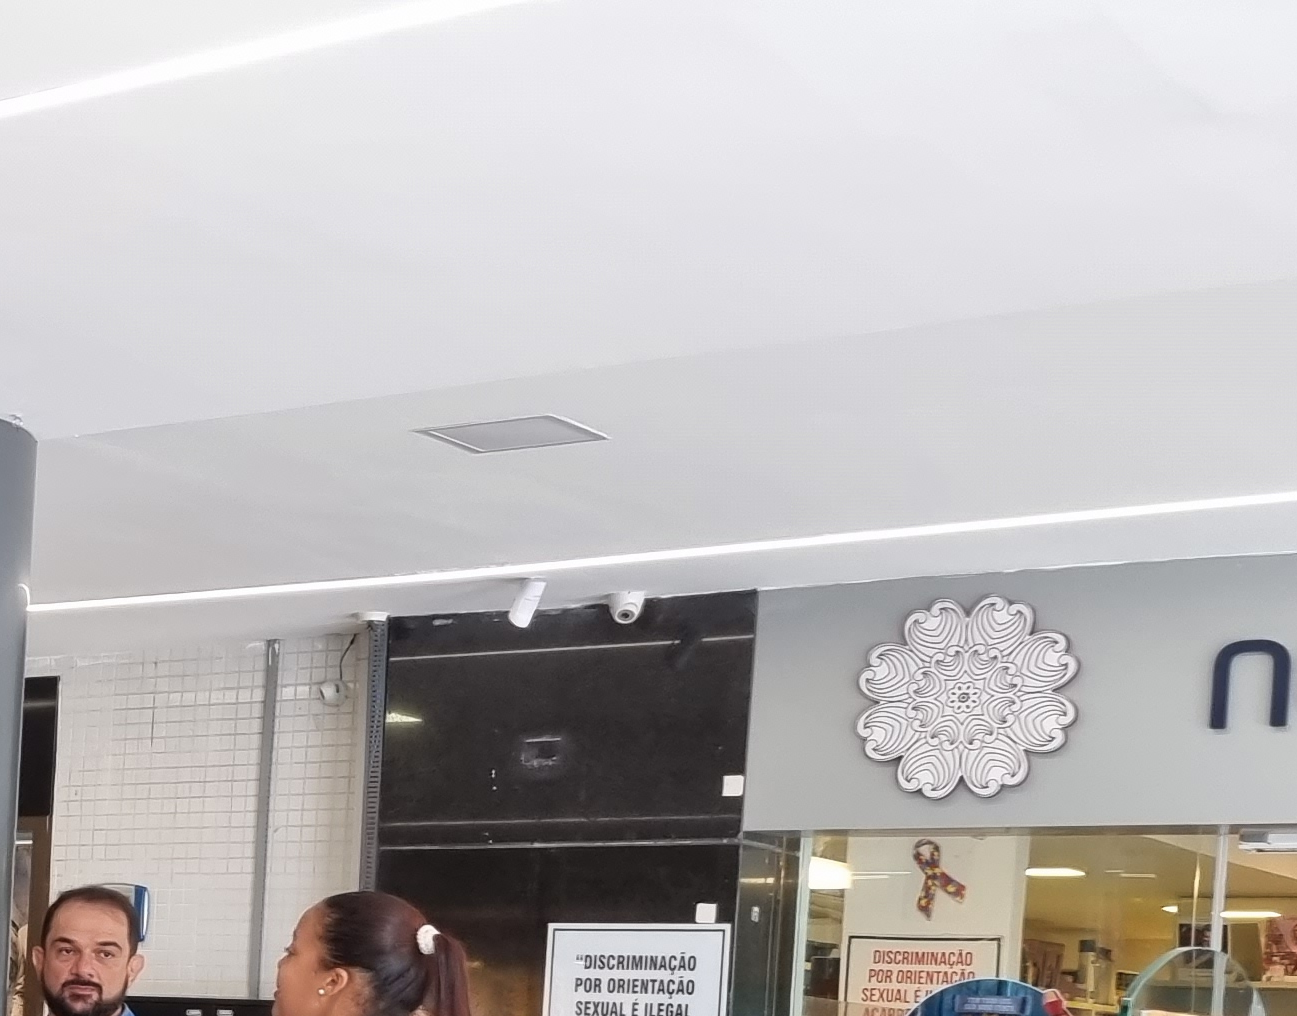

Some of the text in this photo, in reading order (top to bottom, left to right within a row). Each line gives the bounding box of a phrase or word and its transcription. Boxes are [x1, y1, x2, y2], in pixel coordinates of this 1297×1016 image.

[575, 952, 697, 975] “DISCRIMINAÇÃO
[872, 950, 973, 969] DISCRIMINAÇÃO
[868, 969, 893, 984] POR
[574, 976, 695, 999] POR ORIENTAÇÃO
[861, 988, 910, 1003] SEXUAL
[914, 986, 921, 1003] É
